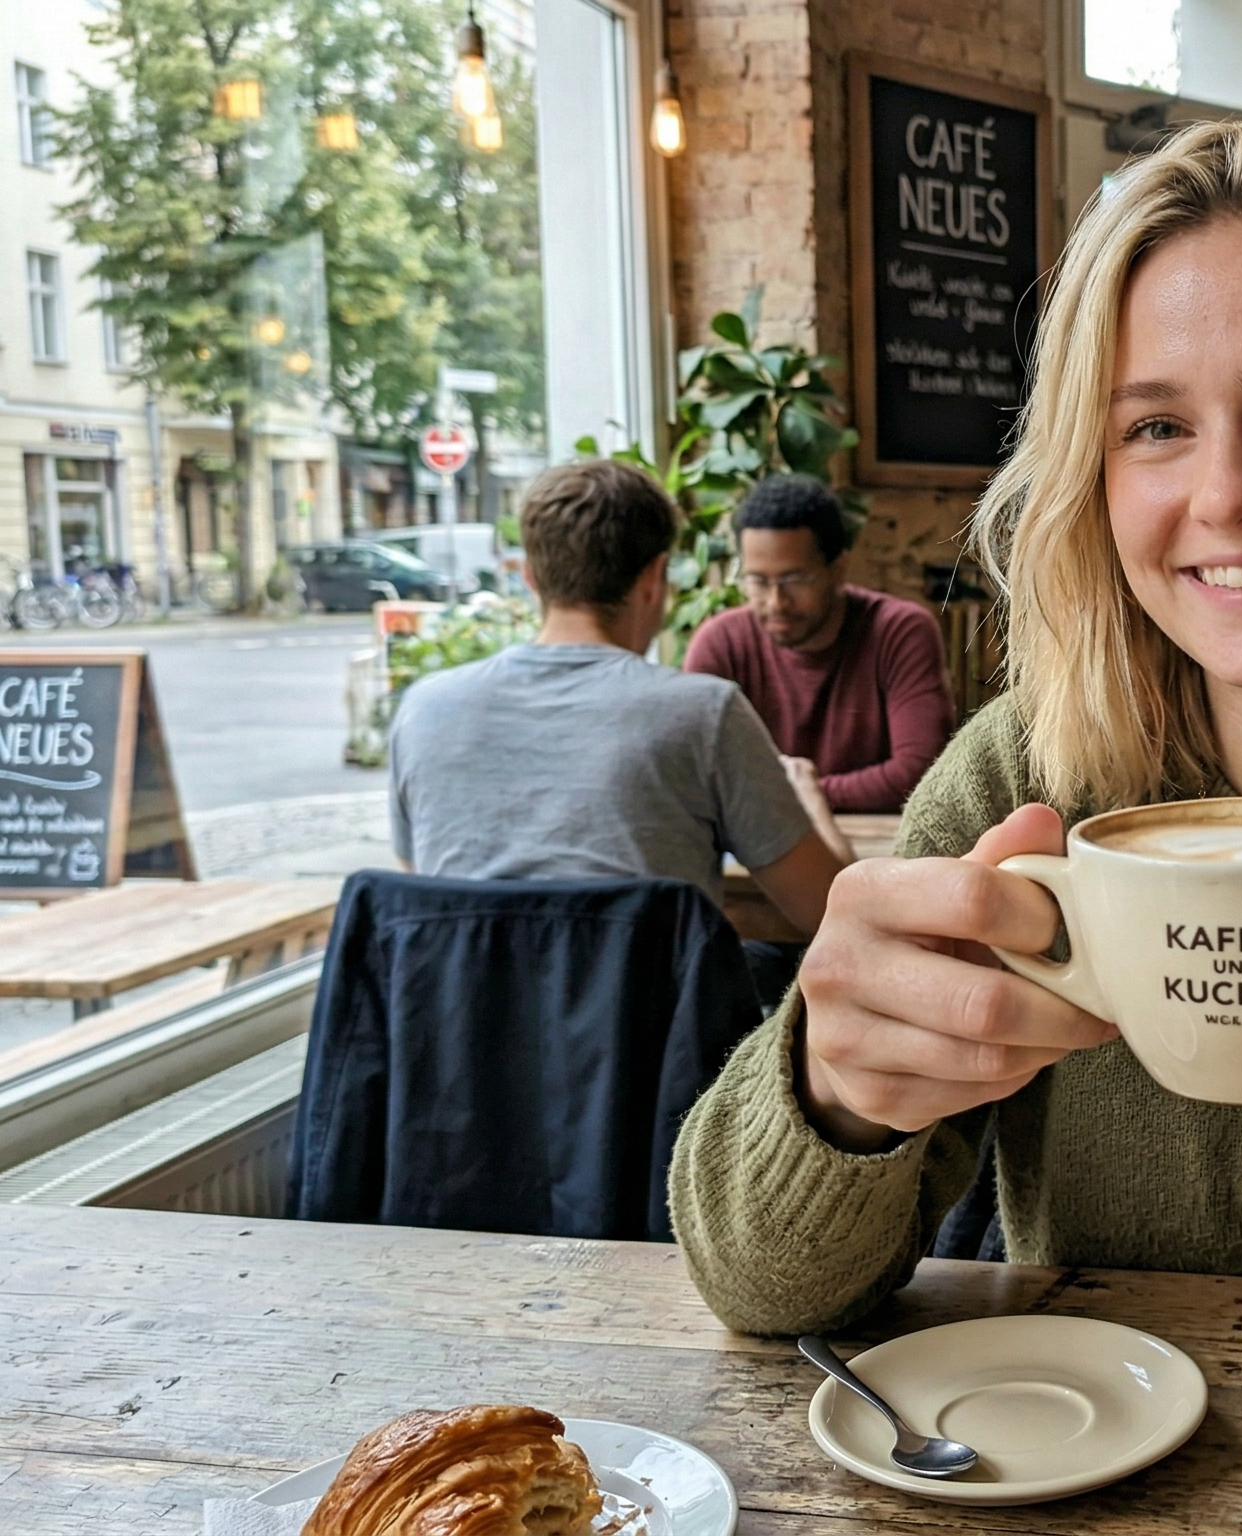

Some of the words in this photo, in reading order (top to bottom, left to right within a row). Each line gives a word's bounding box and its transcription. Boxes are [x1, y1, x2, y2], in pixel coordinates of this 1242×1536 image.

[905, 114, 997, 181] CAFÉ
[898, 172, 1010, 247] NEUES
[0, 667, 84, 718] CAFÉ
